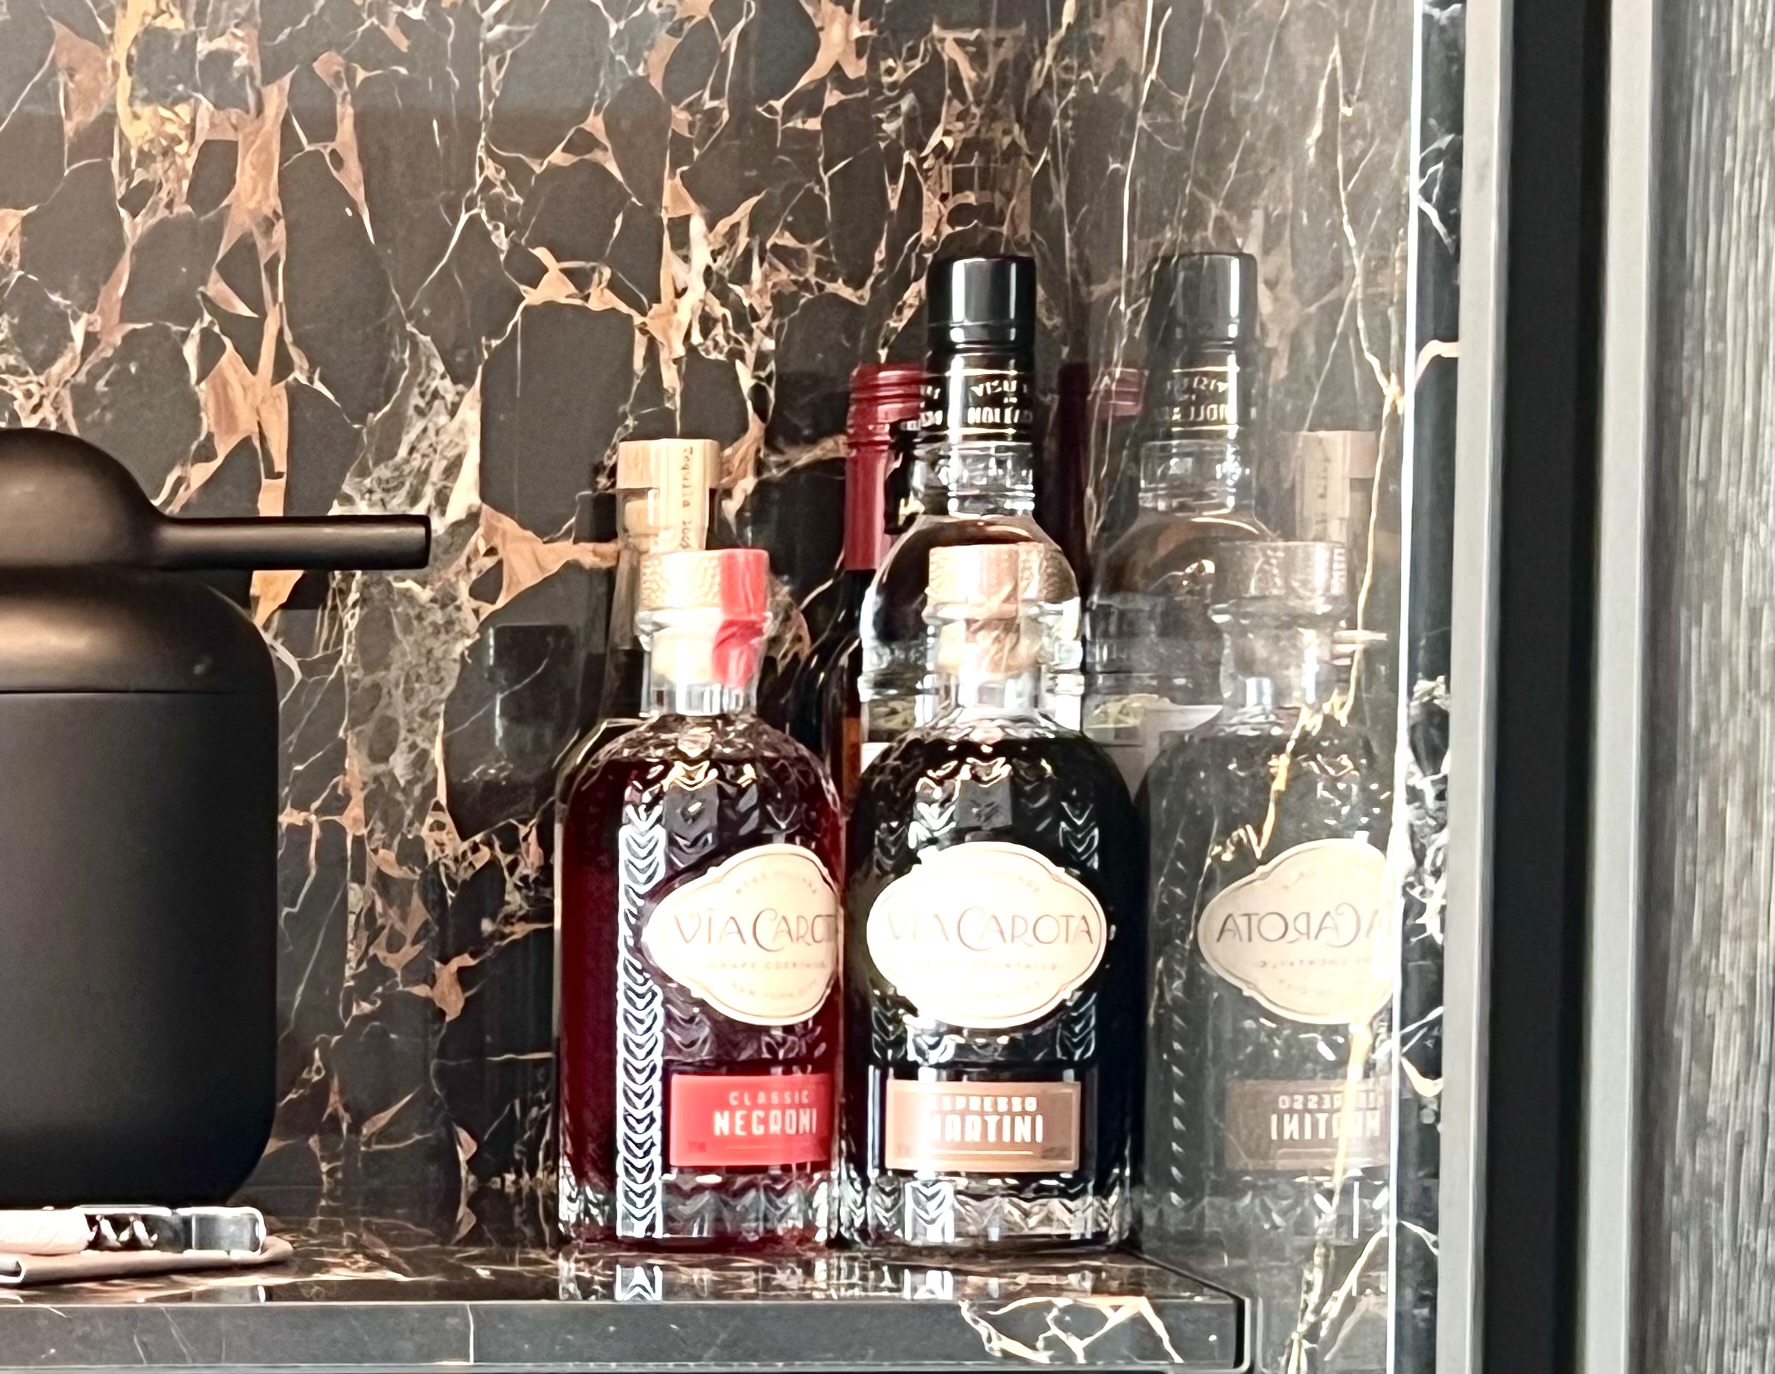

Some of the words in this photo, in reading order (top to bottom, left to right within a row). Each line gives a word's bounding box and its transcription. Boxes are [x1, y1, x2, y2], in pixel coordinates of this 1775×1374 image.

[957, 906, 1094, 952] CAROTA
[728, 1091, 810, 1106] CLASSIC
[713, 1109, 817, 1136] NEGRONI
[926, 1112, 1045, 1144] MARTINI
